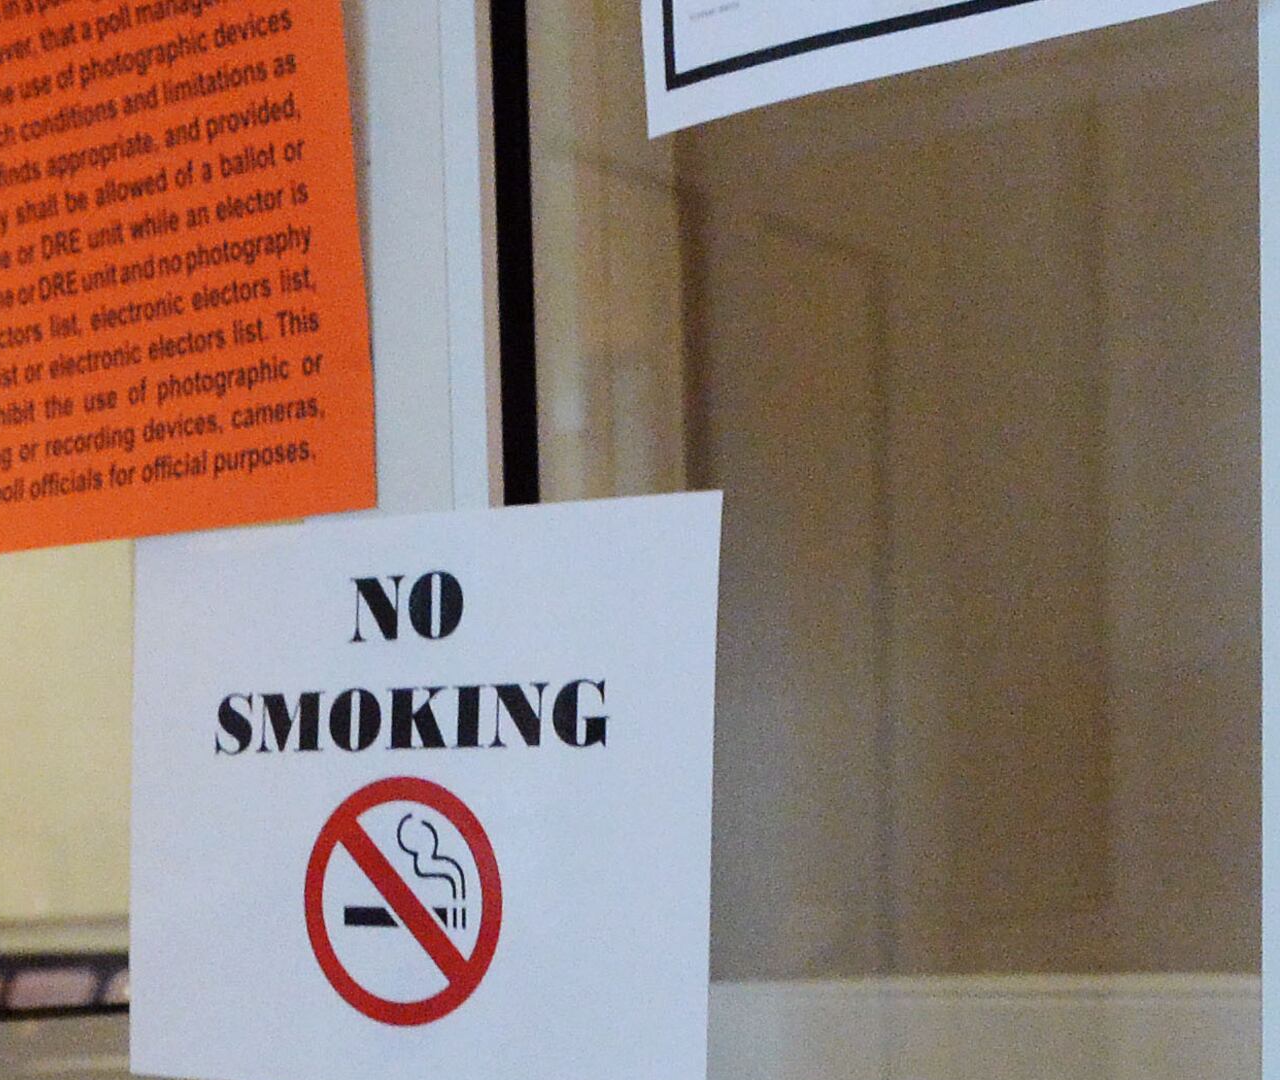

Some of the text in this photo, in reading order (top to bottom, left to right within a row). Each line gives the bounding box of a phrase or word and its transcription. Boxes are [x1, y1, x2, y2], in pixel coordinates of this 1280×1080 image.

[20, 75, 52, 101] use
[56, 63, 74, 91] of
[79, 31, 208, 90] photographic
[213, 8, 292, 50] devices
[39, 22, 77, 52] that
[96, 4, 132, 42] poll
[20, 99, 118, 143] conditions
[123, 84, 158, 116] and
[163, 61, 268, 104] limitations
[273, 52, 297, 79] as
[164, 116, 201, 149] and
[16, 194, 58, 226] shall
[65, 191, 88, 215] be
[95, 168, 168, 208] allowed
[174, 159, 194, 189] of
[219, 142, 276, 179] ballot
[283, 139, 305, 164] or
[17, 244, 36, 266] or
[40, 227, 82, 262] DRE
[87, 222, 125, 251] unit
[186, 205, 210, 229] an
[215, 188, 283, 223] elector
[291, 182, 309, 206] is
[17, 285, 35, 306] or
[38, 269, 78, 302] DRE
[81, 264, 118, 293] unit
[120, 256, 156, 285] and
[159, 254, 183, 275] no
[186, 224, 312, 277] photography
[90, 295, 184, 332] electronic
[191, 277, 272, 312] electors
[24, 363, 44, 384] or
[49, 345, 141, 380] electronic
[148, 328, 227, 361] electors
[275, 309, 320, 338] This
[44, 396, 74, 419] the
[84, 390, 118, 413] use
[128, 377, 147, 406] of
[157, 358, 290, 405] photographic
[301, 353, 323, 377] or
[19, 442, 40, 463] or
[45, 426, 136, 457] recording
[142, 413, 224, 443] devices,
[231, 397, 326, 430] cameras,
[30, 469, 103, 500] officials
[109, 463, 137, 488] for
[142, 450, 209, 484] official
[213, 440, 316, 479] purposes.
[349, 570, 465, 643] NO
[214, 678, 611, 756] SMOKING
